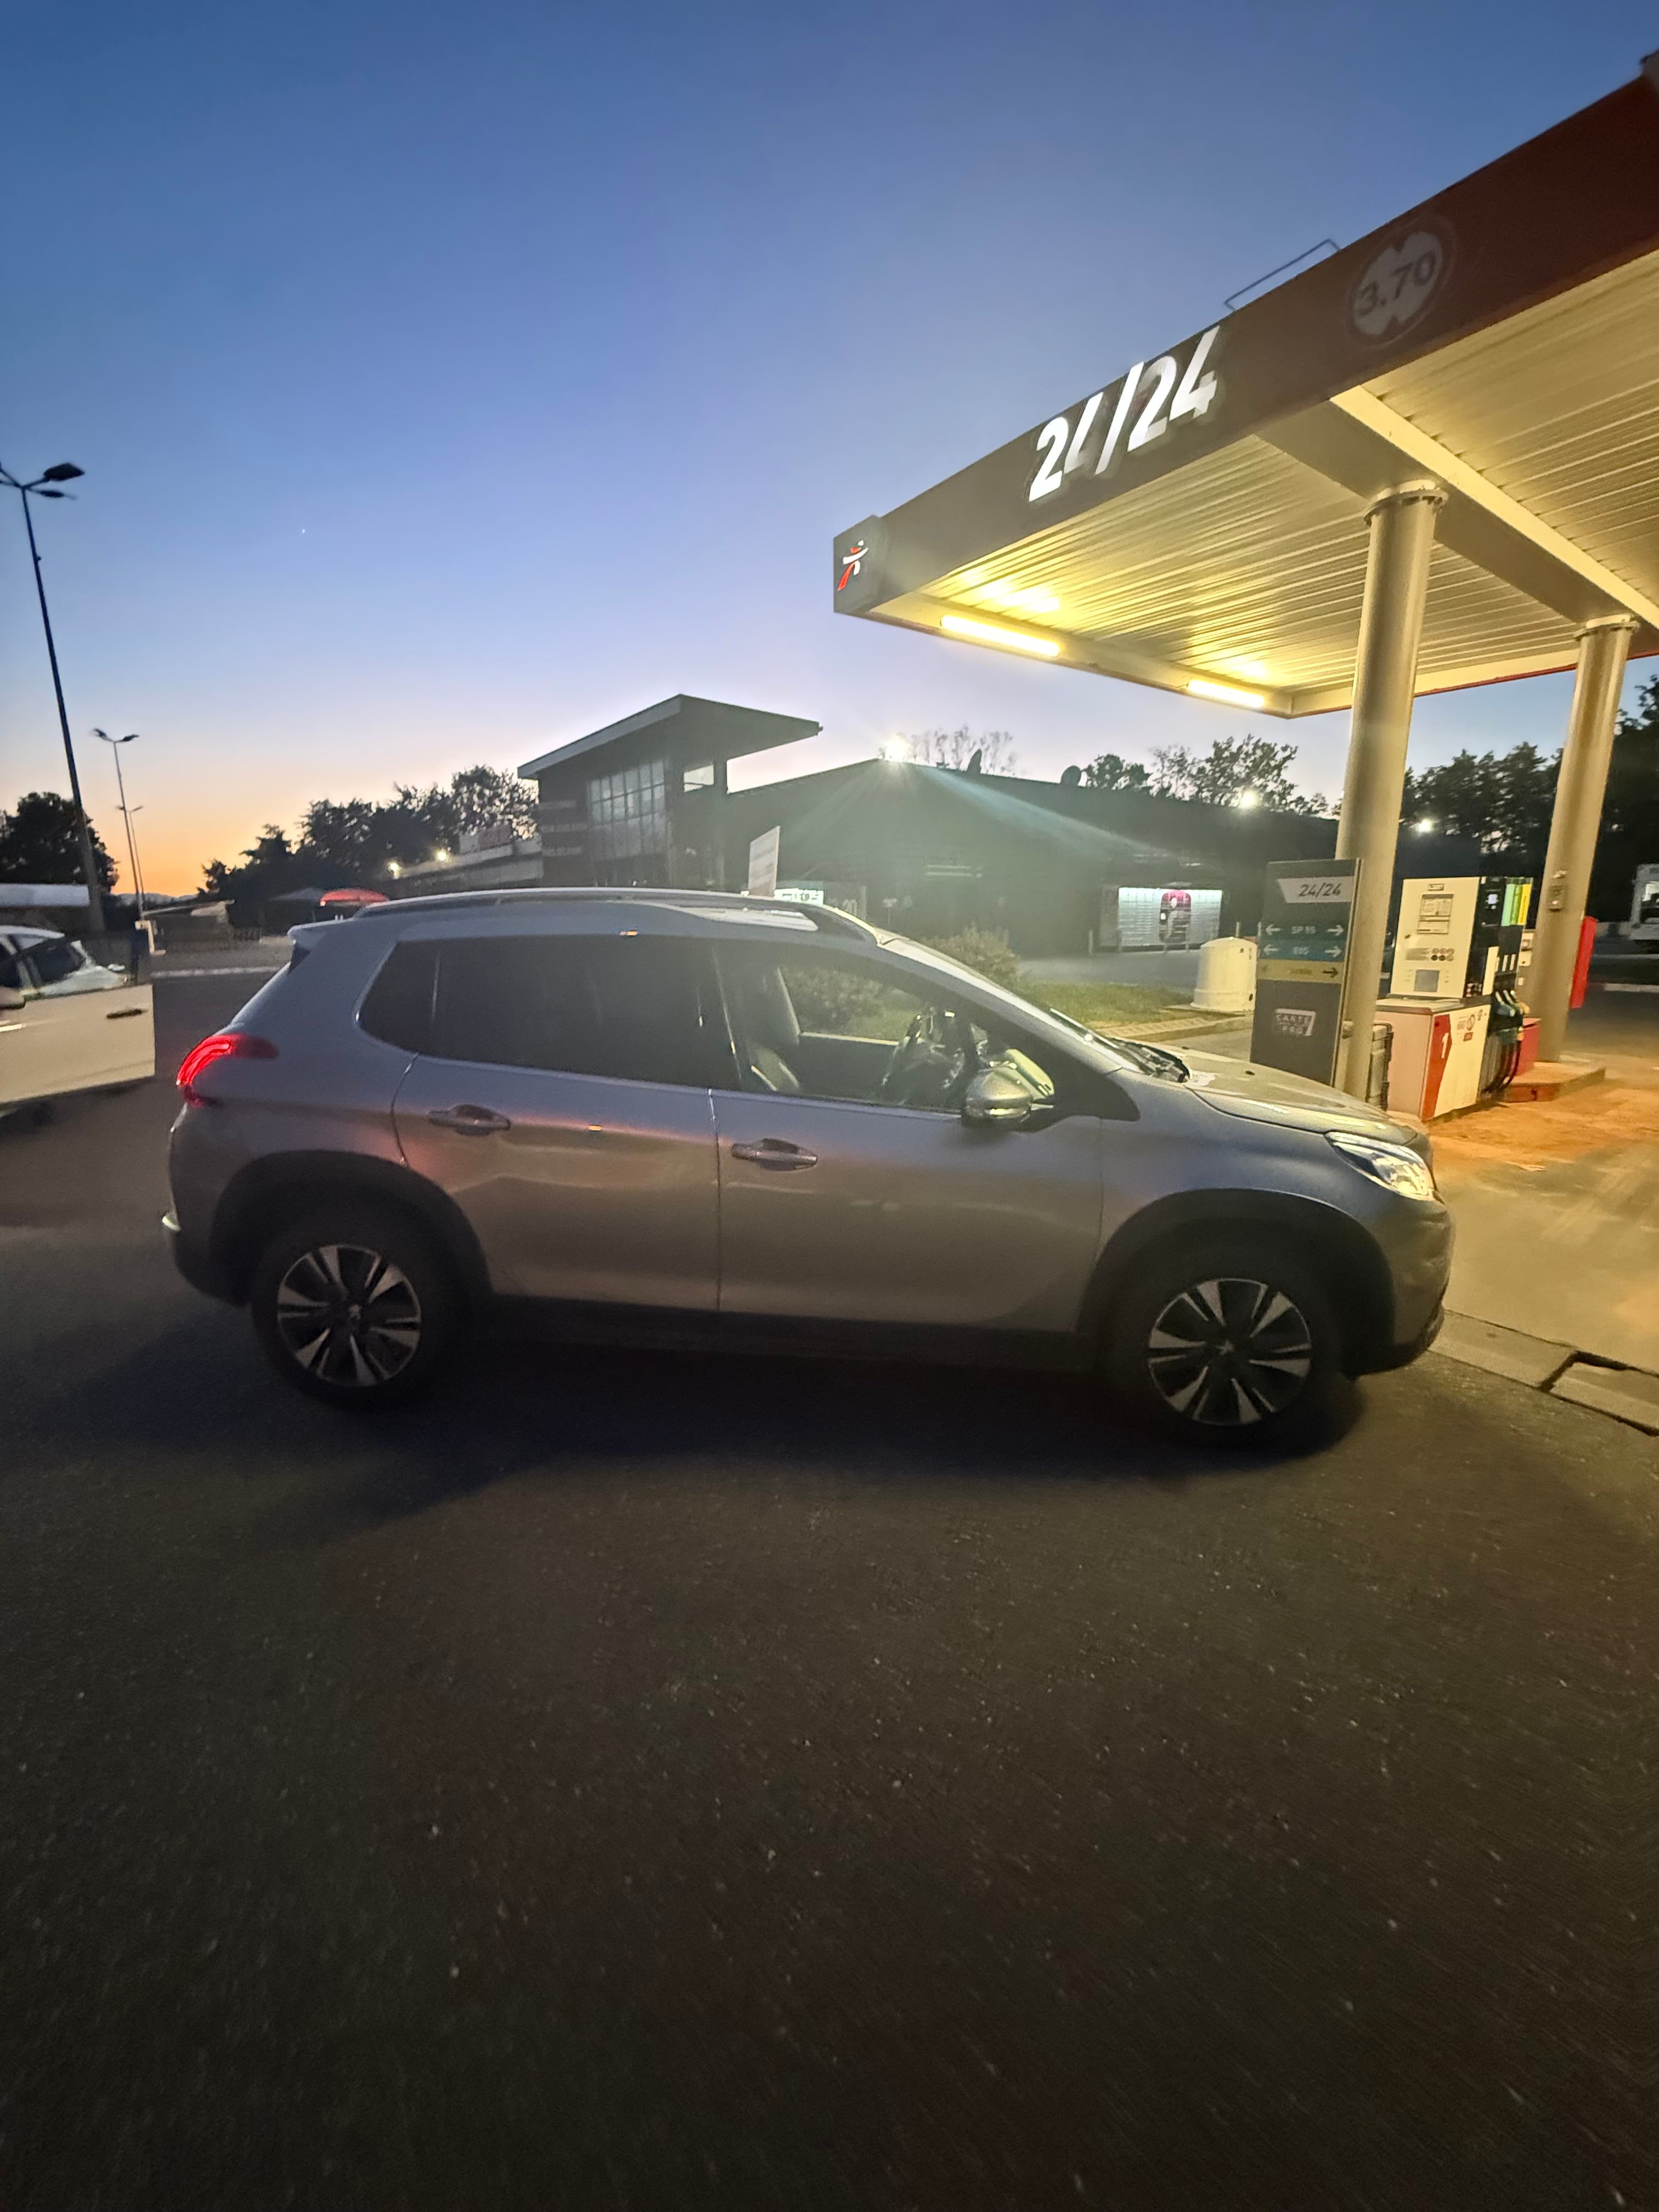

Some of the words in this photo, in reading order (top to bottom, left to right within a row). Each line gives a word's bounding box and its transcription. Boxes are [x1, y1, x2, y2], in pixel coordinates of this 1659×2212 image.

[1358, 251, 1436, 317] 3.70
[1028, 325, 1220, 503] 24/24
[1298, 882, 1342, 897] 24/24
[1441, 1032, 1449, 1059] 1
